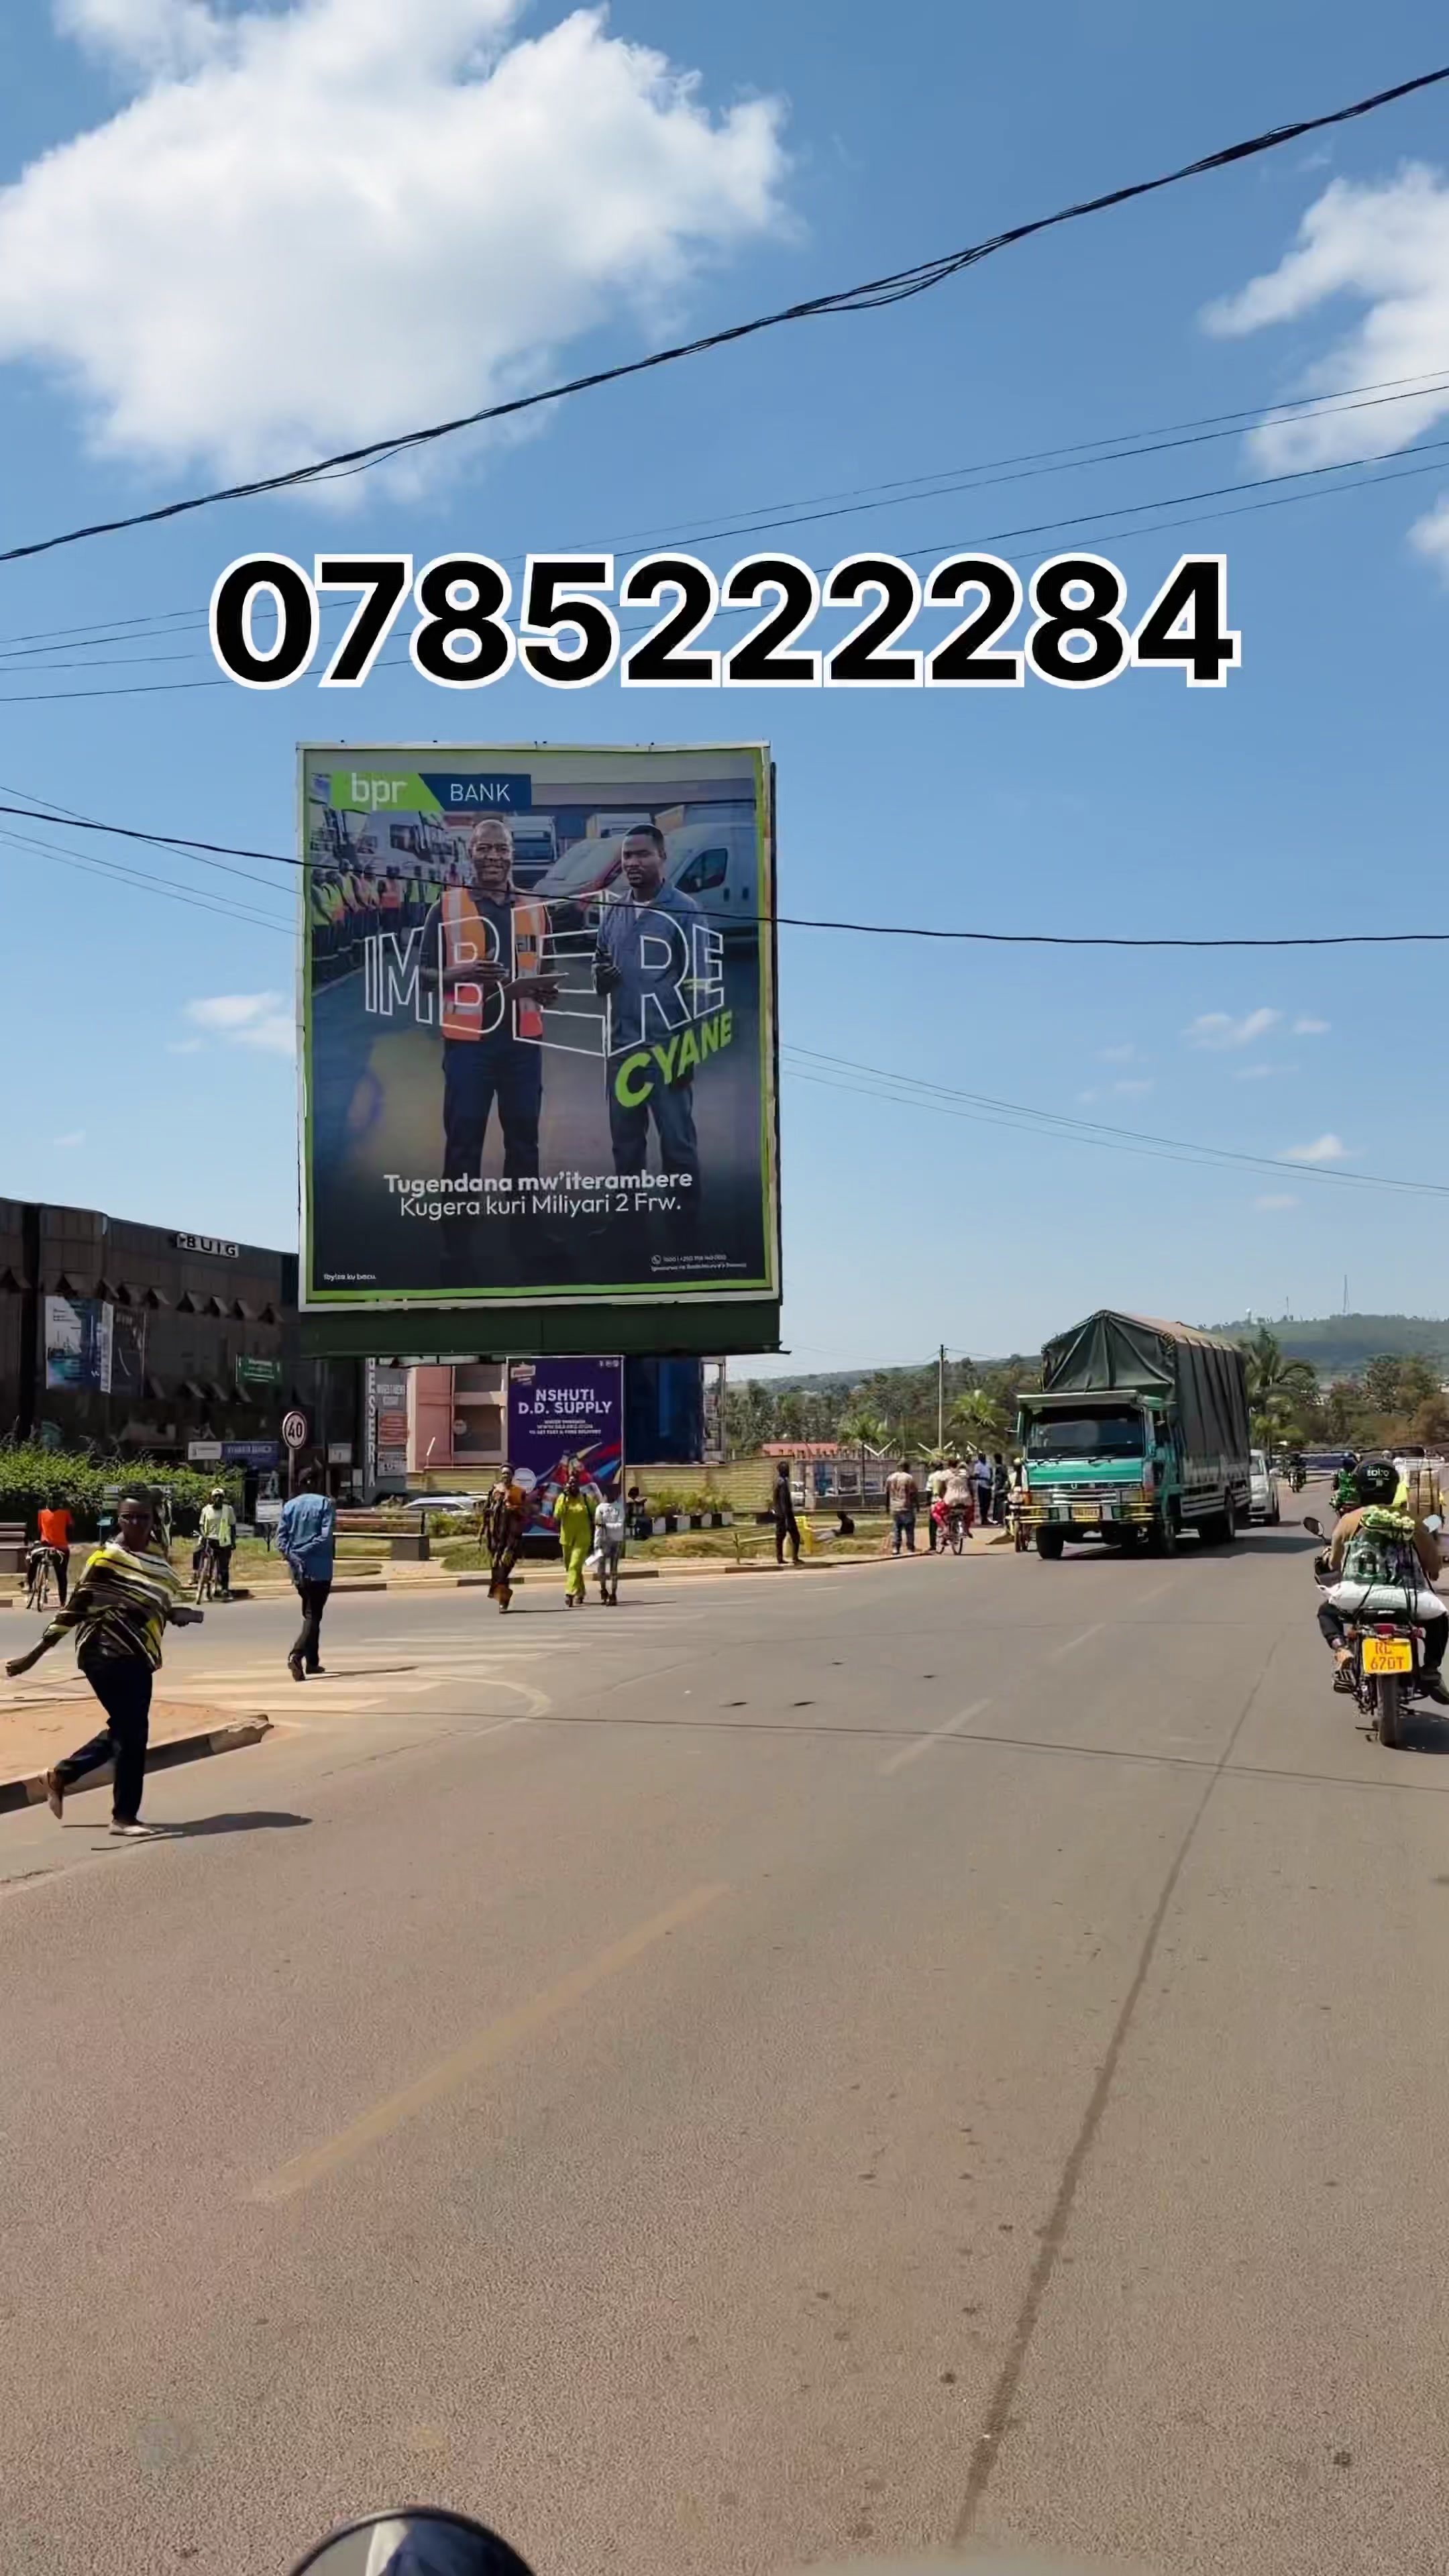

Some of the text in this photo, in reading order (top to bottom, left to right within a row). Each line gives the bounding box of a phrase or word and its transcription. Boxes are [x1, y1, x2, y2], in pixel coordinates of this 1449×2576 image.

[351, 771, 511, 811] bpr BANK
[614, 1008, 733, 1108] CYANE
[383, 1169, 693, 1198] Tugendana mw'iterambere
[400, 1192, 682, 1221] Kugera kuri Miliyari 2 Frw.
[187, 1236, 236, 1256] BUIG
[535, 1389, 595, 1402] NSHUTI
[518, 1401, 613, 1415] D.D. SUPPLY
[288, 1421, 303, 1438] 40
